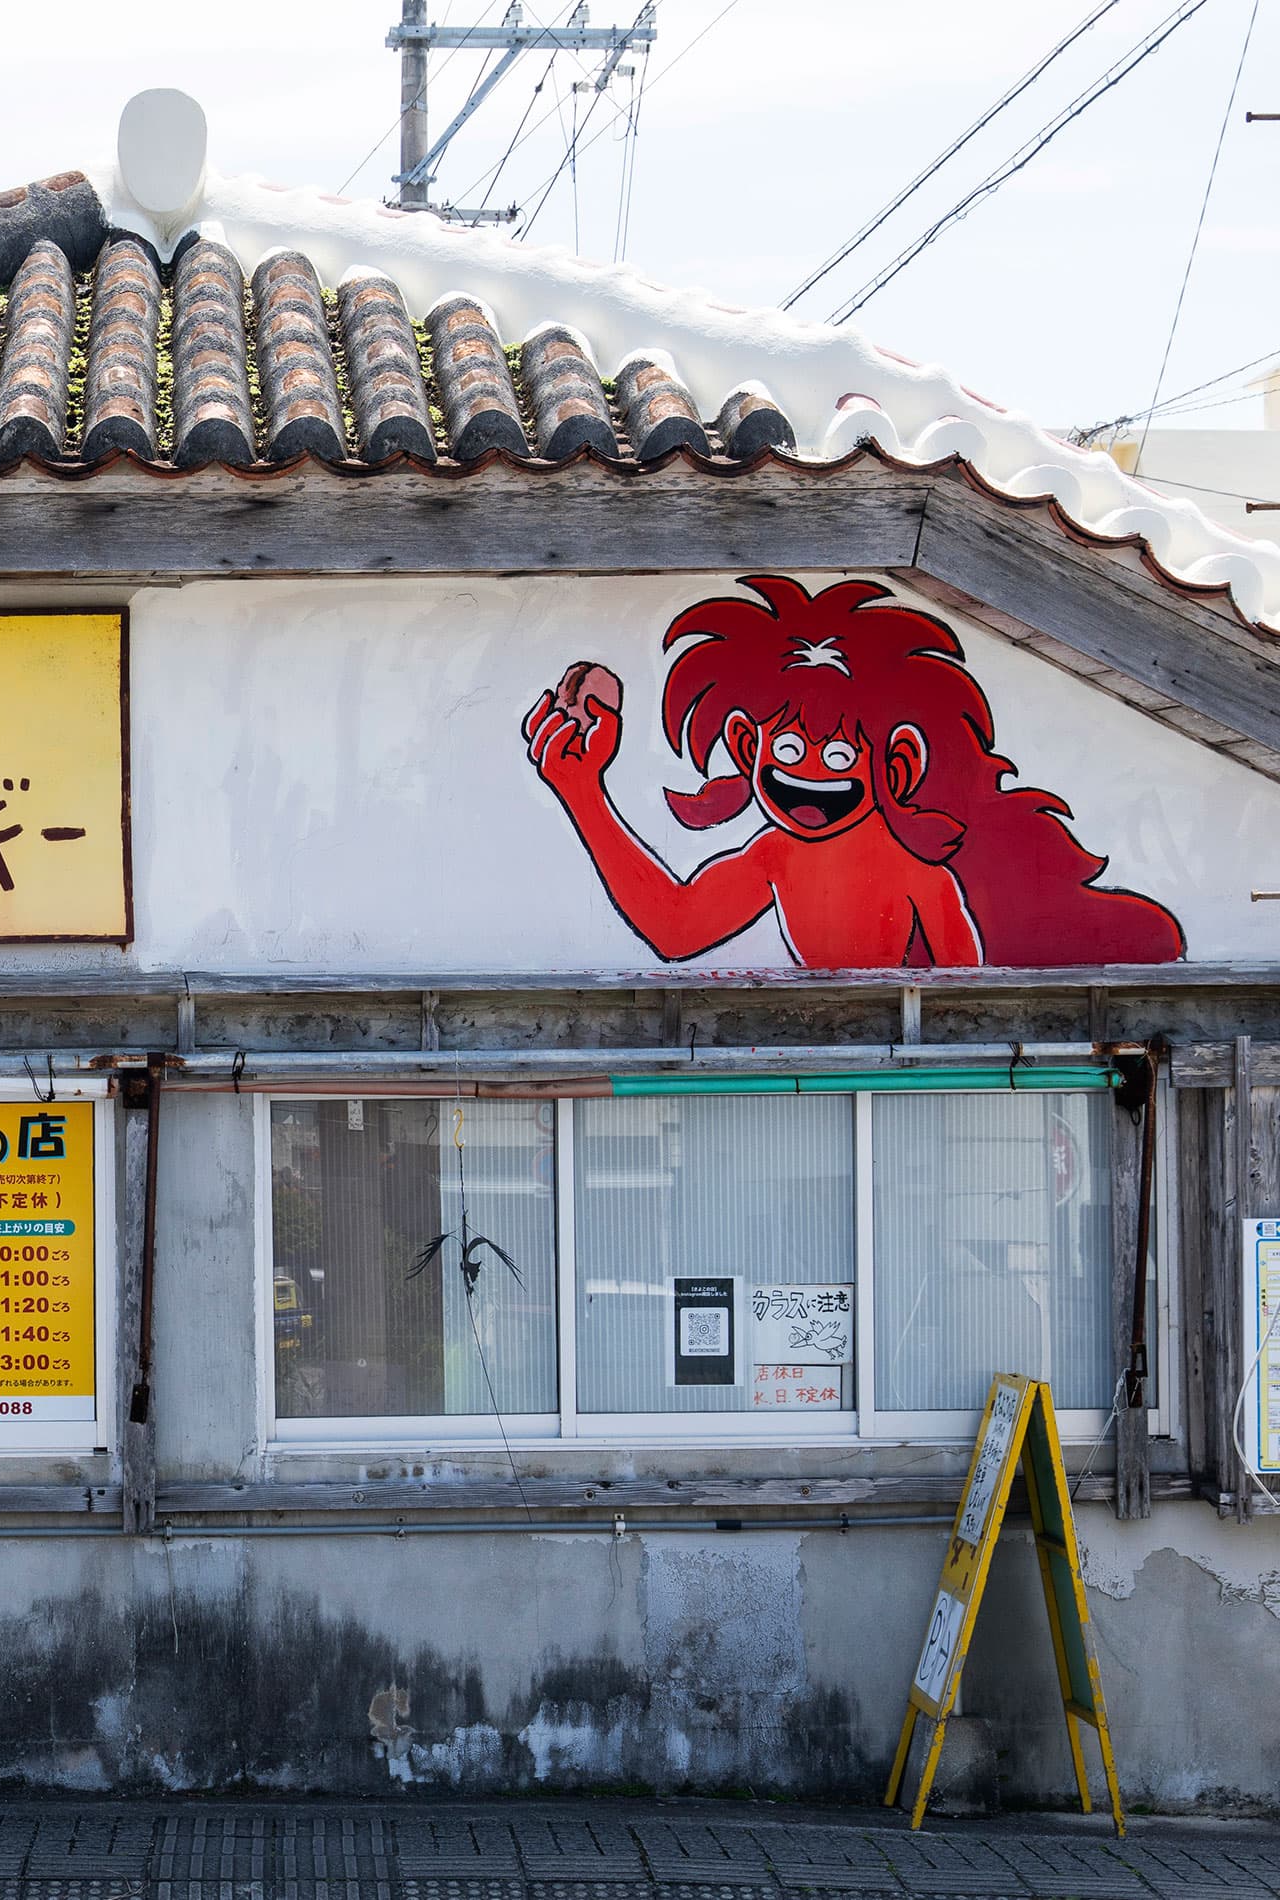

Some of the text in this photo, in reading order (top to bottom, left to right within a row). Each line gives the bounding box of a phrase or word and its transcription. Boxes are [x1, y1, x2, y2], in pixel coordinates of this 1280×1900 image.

[753, 1290, 850, 1321] カラスに注意
[754, 1365, 804, 1383] 店休日
